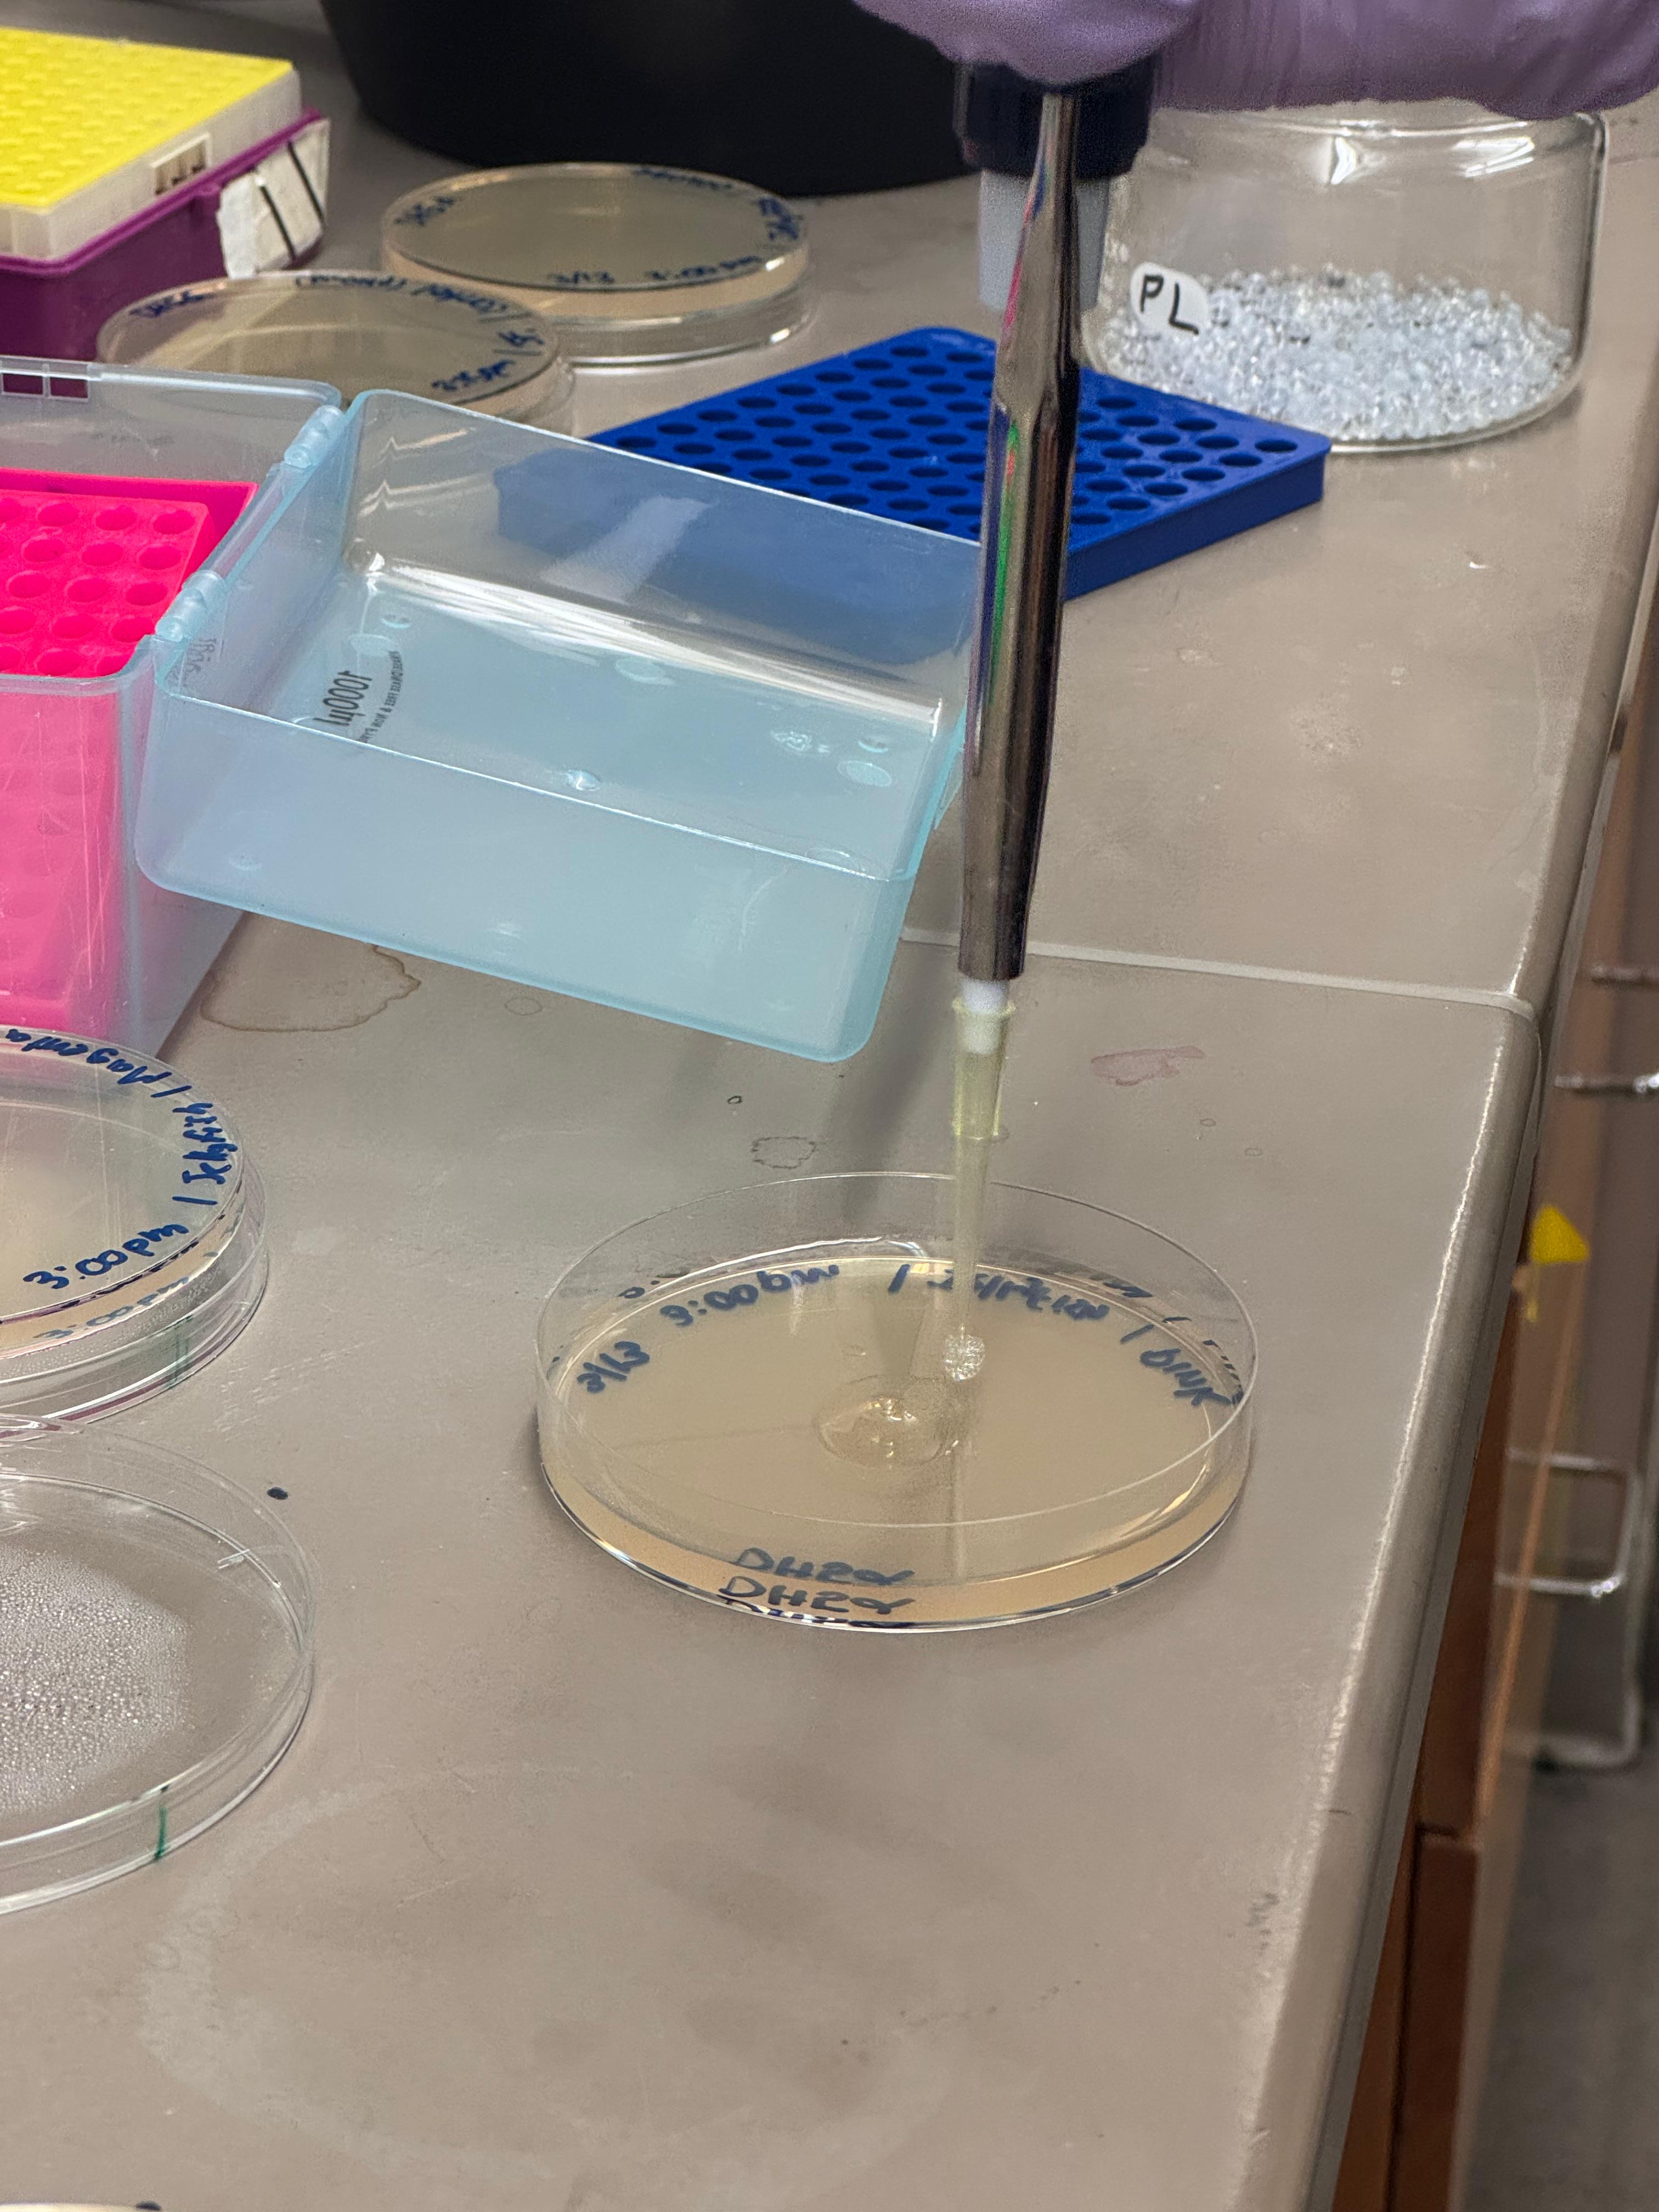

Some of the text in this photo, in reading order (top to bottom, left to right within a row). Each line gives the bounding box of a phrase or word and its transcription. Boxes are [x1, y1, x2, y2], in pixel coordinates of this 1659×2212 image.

[1139, 274, 1199, 335] PL
[5, 1028, 173, 1085] Magenta
[22, 1223, 189, 1290] 3:00pm
